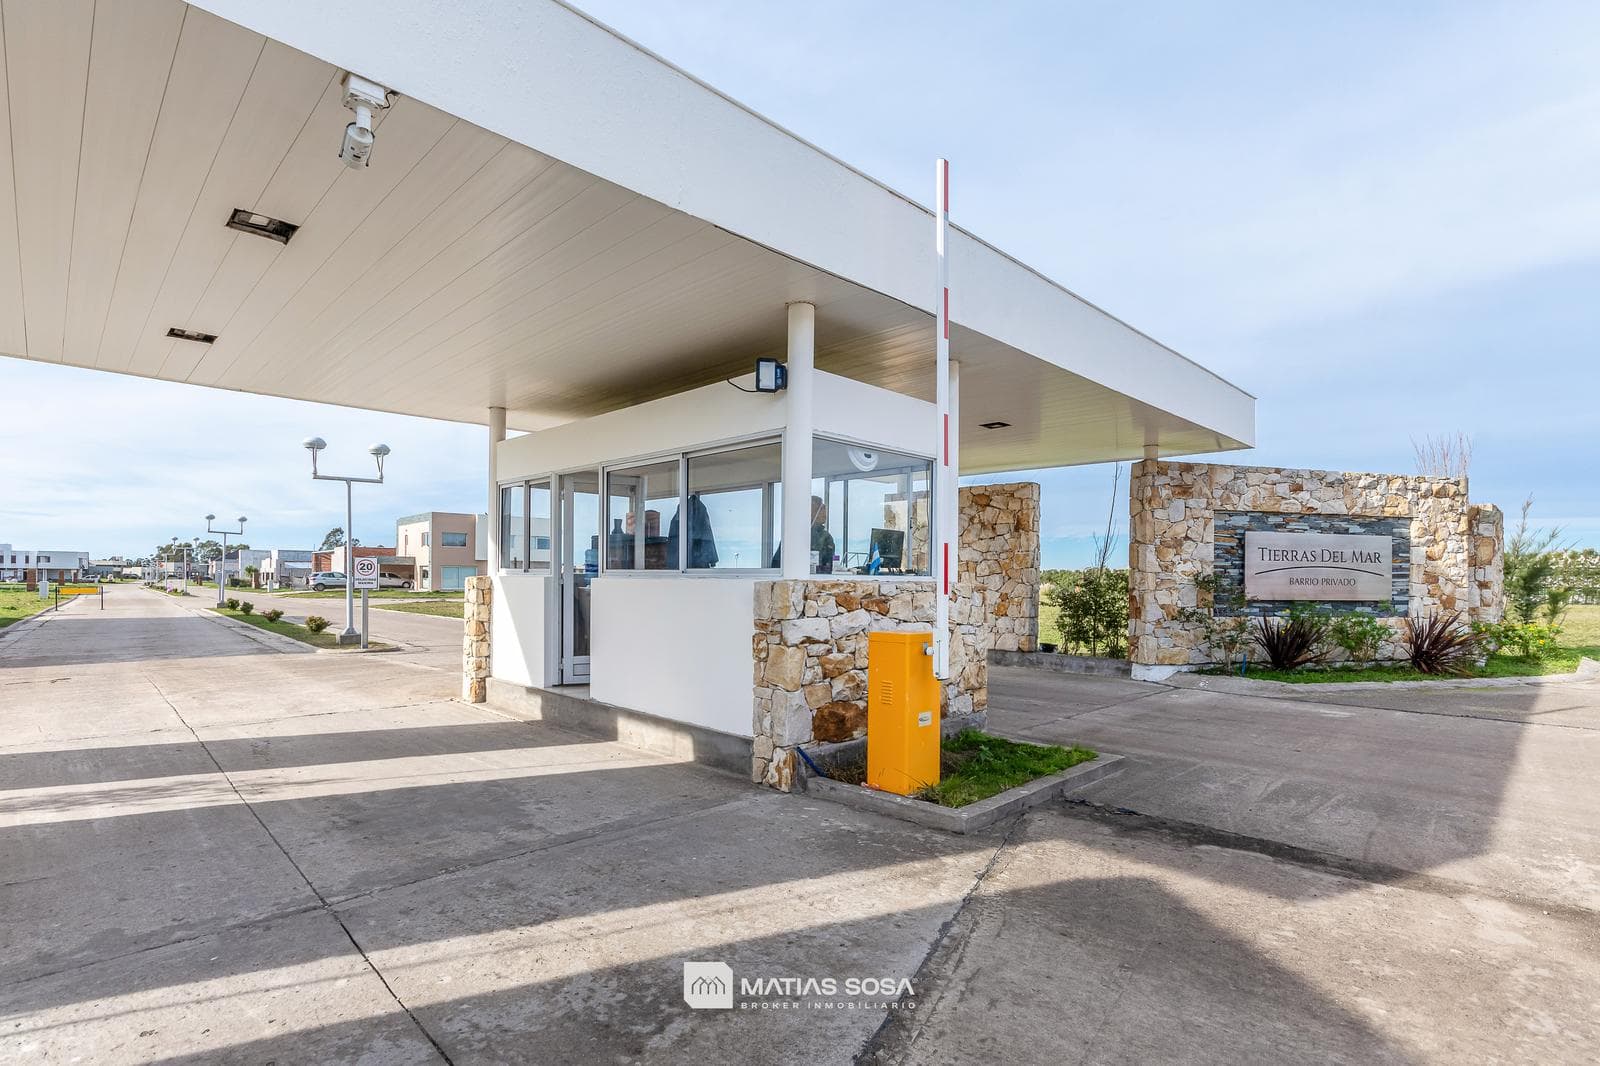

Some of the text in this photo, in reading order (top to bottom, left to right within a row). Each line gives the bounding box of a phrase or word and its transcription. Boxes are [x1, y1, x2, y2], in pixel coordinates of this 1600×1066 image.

[359, 562, 373, 570] 20
[1289, 577, 1356, 586] BARRIO PRIVADO
